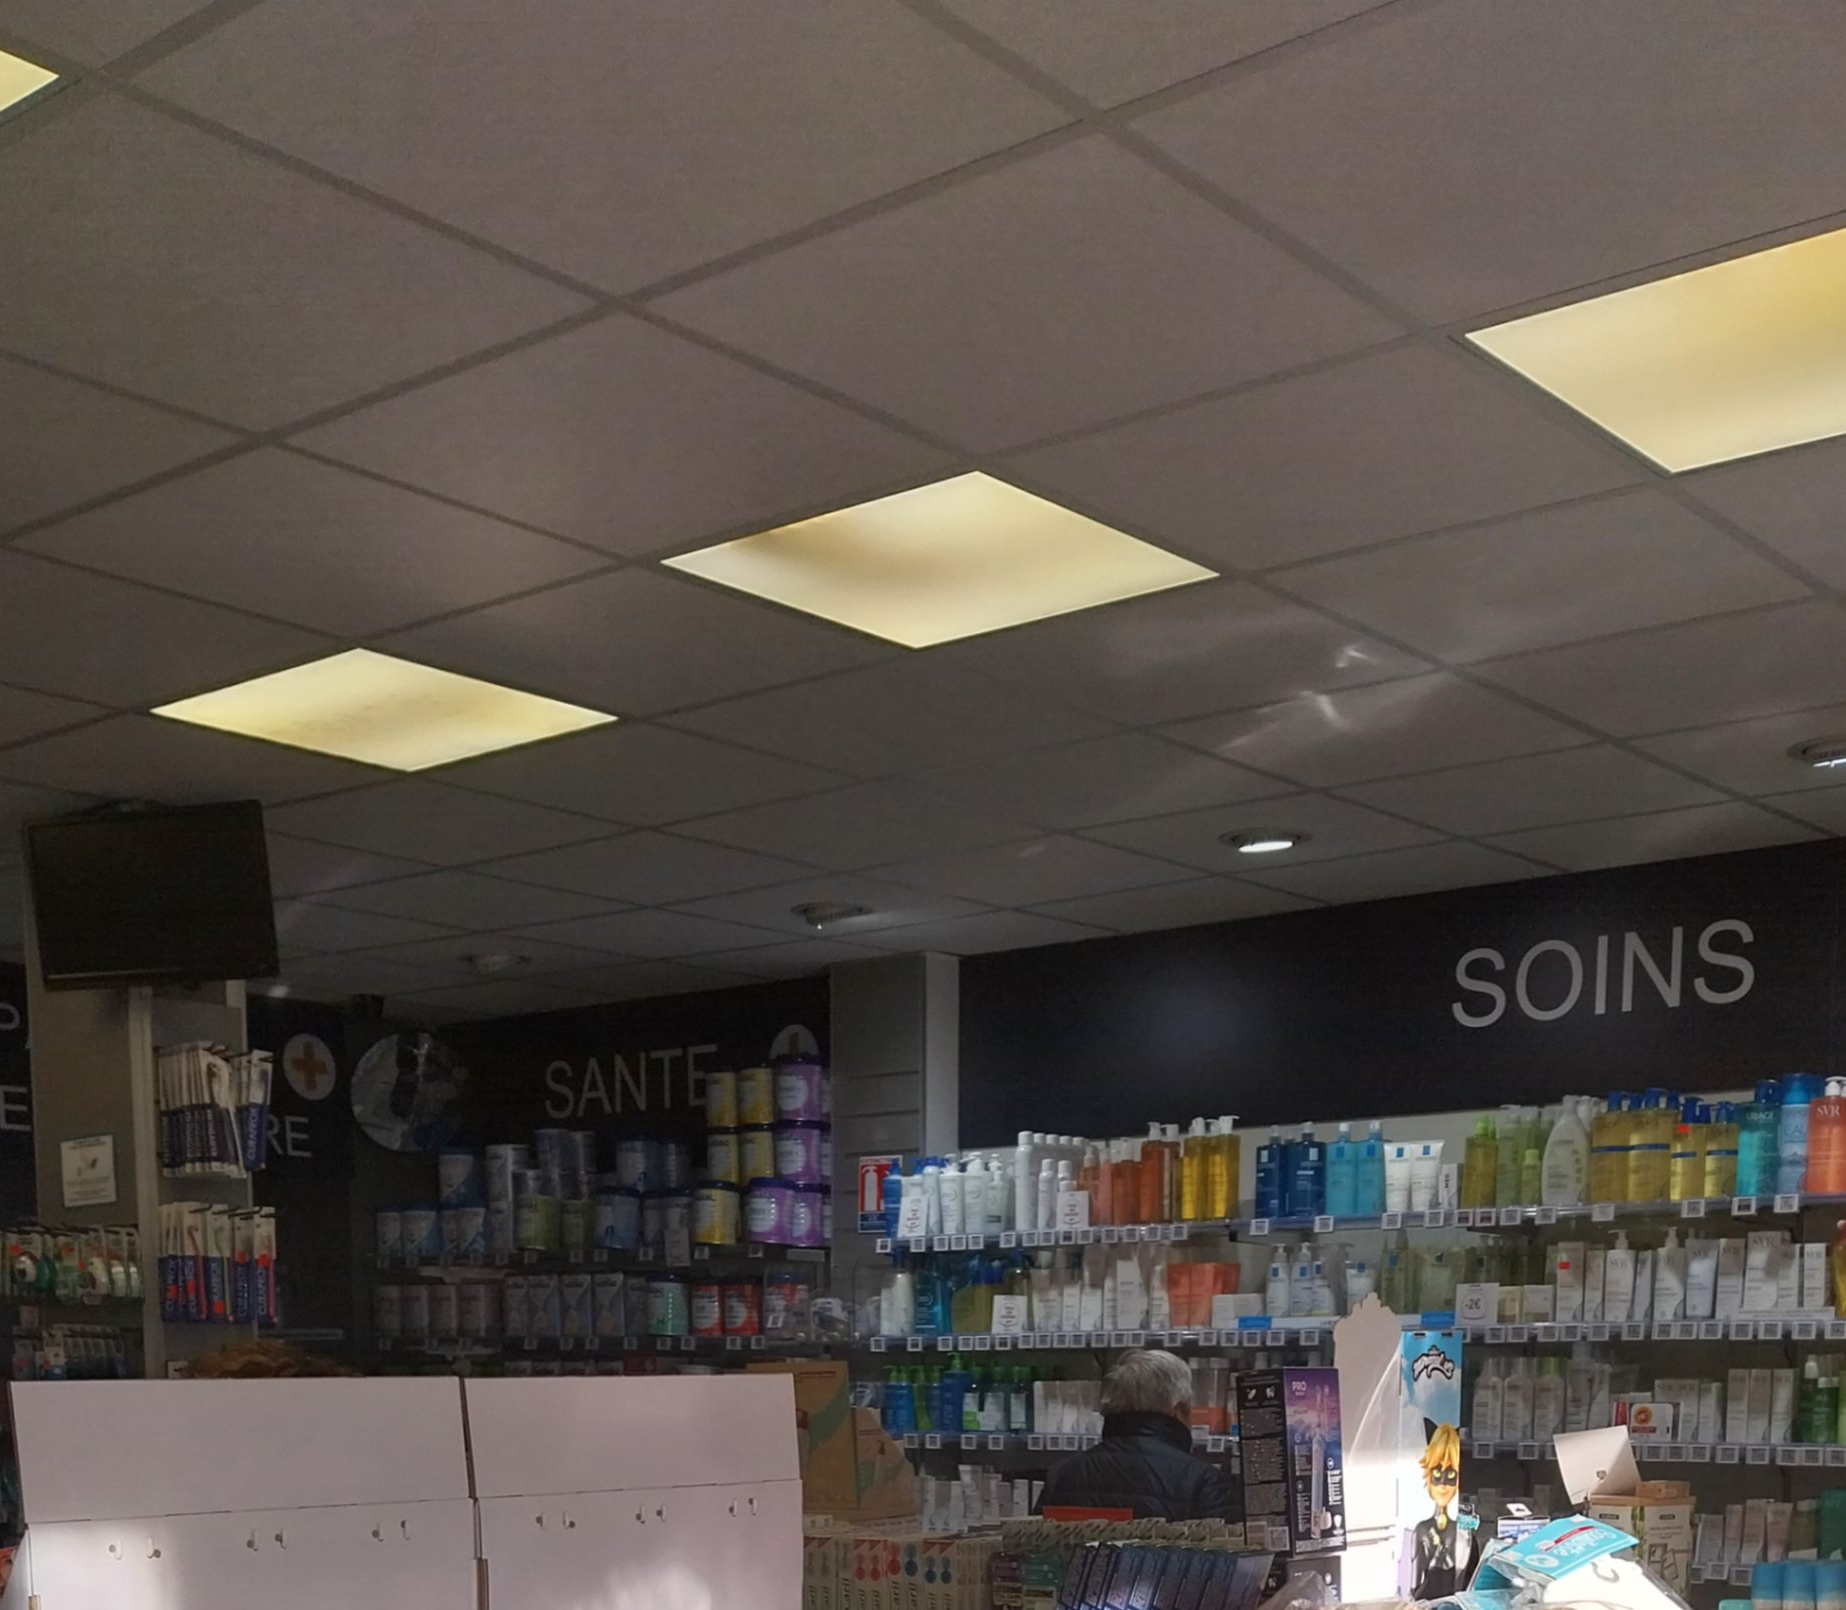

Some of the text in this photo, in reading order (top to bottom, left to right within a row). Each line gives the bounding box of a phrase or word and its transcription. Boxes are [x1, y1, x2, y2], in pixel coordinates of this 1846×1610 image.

[1452, 919, 1756, 1027] SOINS
[1816, 1104, 1841, 1118] SVR
[1465, 1298, 1481, 1311] -2€
[1292, 1380, 1306, 1391] PRO
